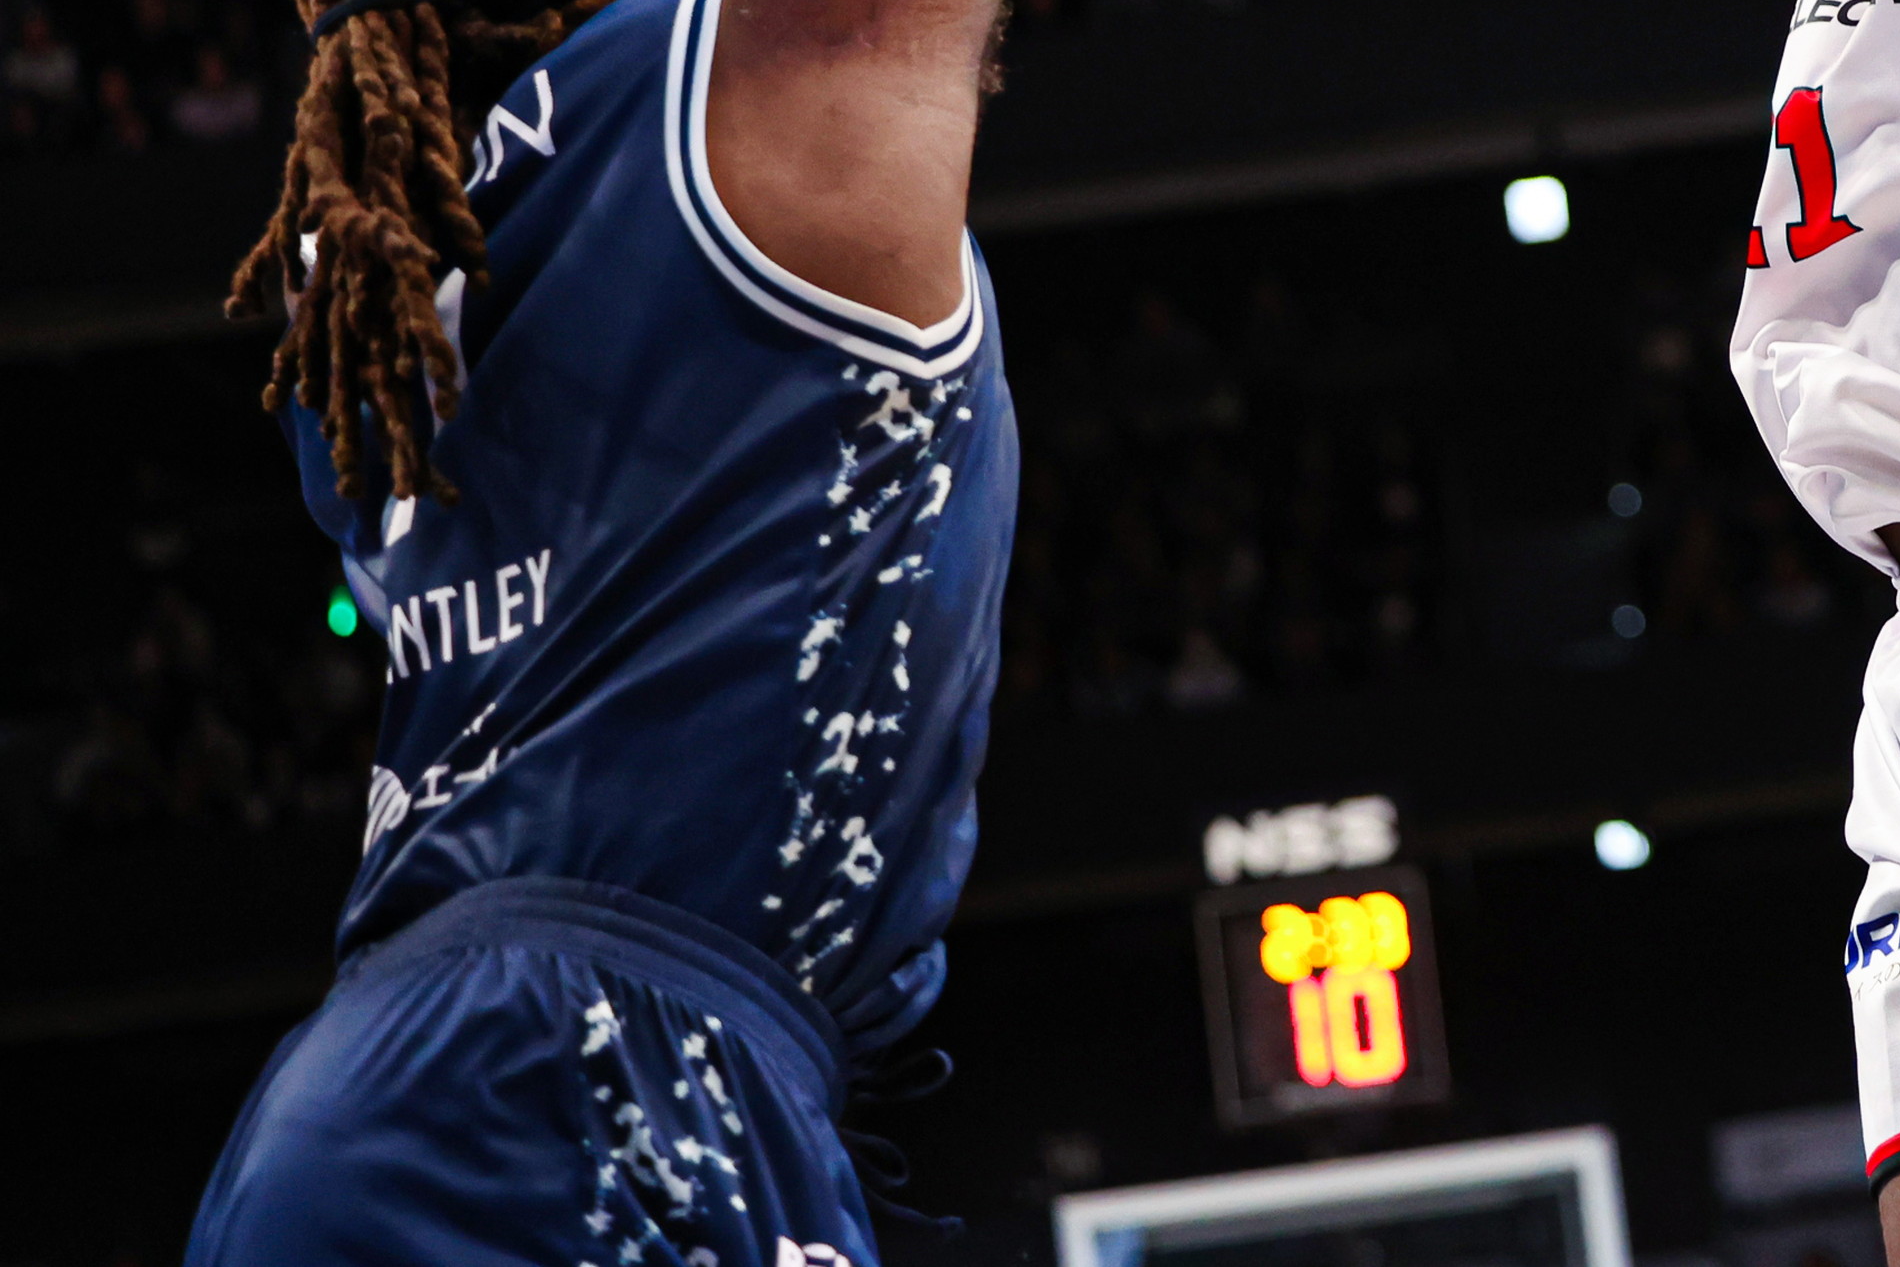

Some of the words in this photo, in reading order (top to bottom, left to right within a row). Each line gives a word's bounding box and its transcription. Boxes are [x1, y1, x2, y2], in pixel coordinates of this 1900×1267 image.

[1746, 86, 1863, 269] 1
[386, 548, 551, 685] NTLEY
[1288, 966, 1408, 1088] 10
